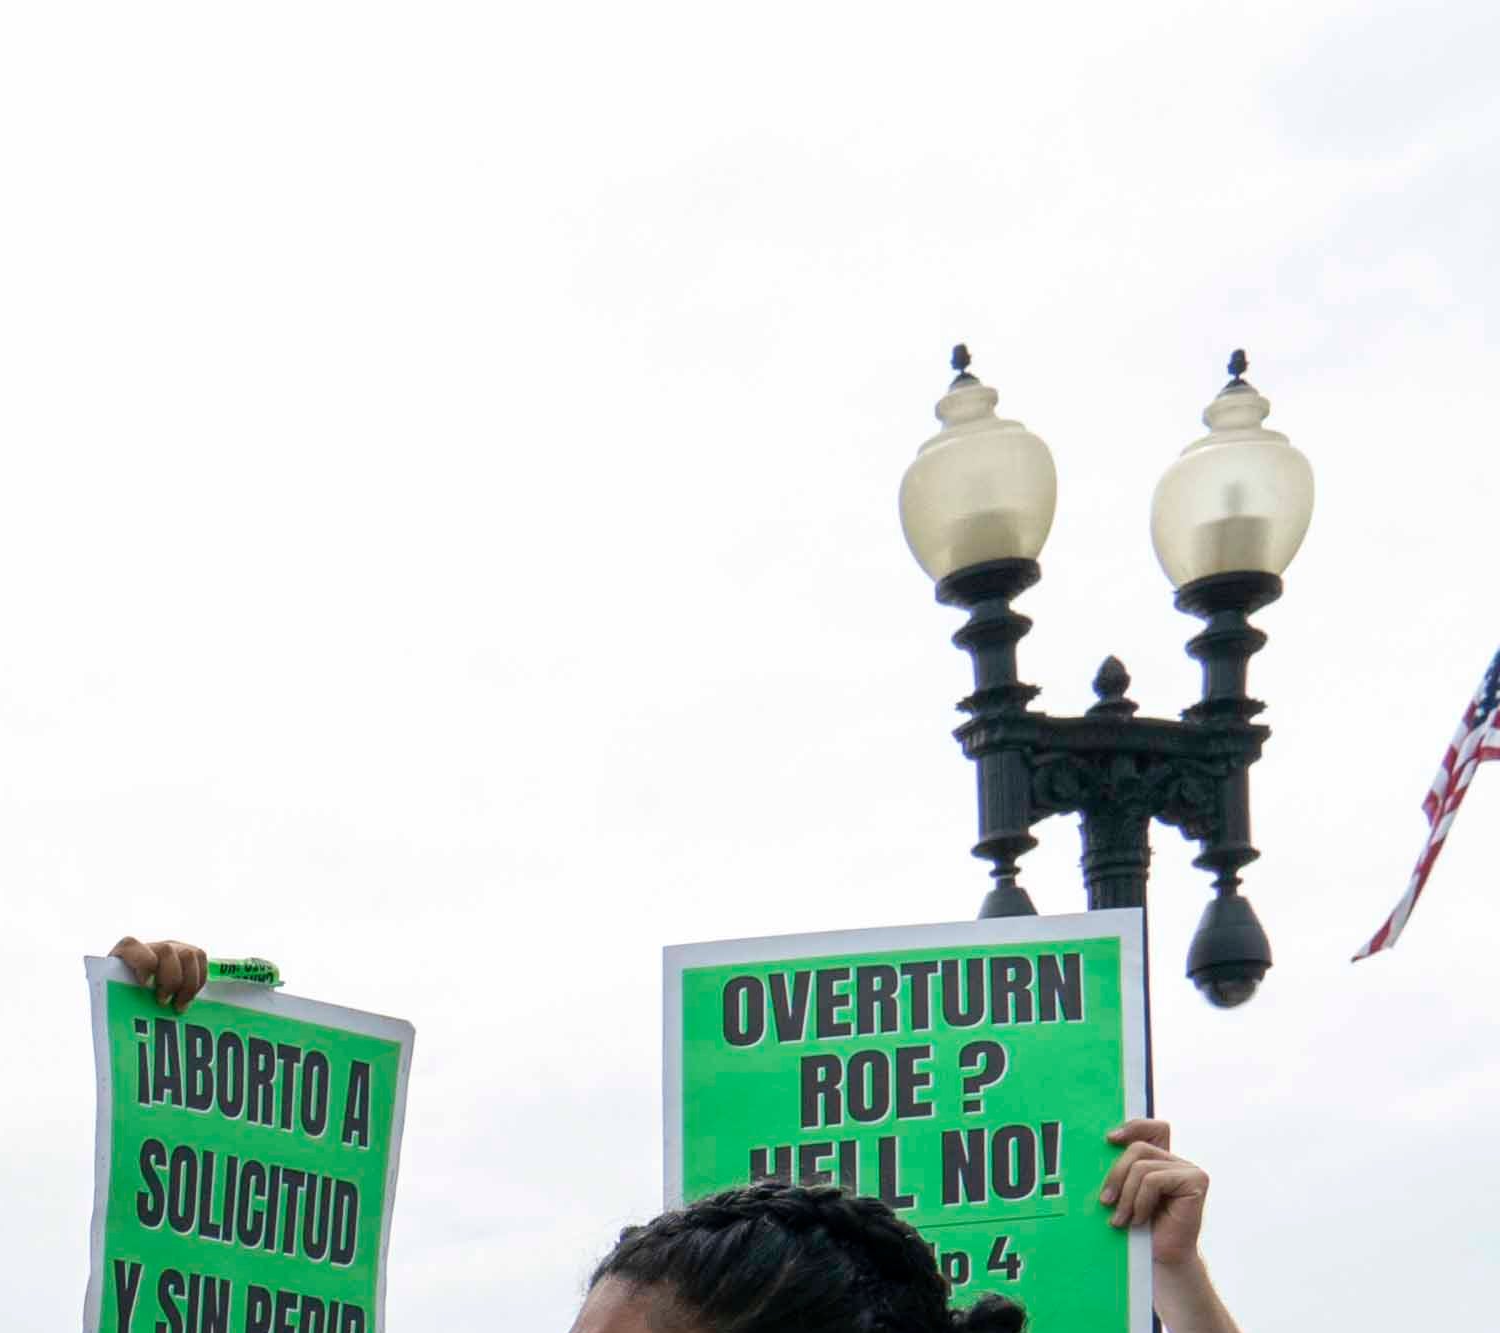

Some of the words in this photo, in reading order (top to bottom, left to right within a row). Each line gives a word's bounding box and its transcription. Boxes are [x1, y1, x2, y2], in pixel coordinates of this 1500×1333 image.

[722, 953, 1085, 1048] OVERTURN
[132, 1016, 330, 1138] ¡ABORTO
[341, 1059, 371, 1150] A
[800, 1044, 935, 1130] ROE
[958, 1040, 1008, 1116] ?
[135, 1138, 360, 1268] SOLICITUD
[941, 1121, 1063, 1207] NO!
[986, 1235, 1022, 1282] 4
